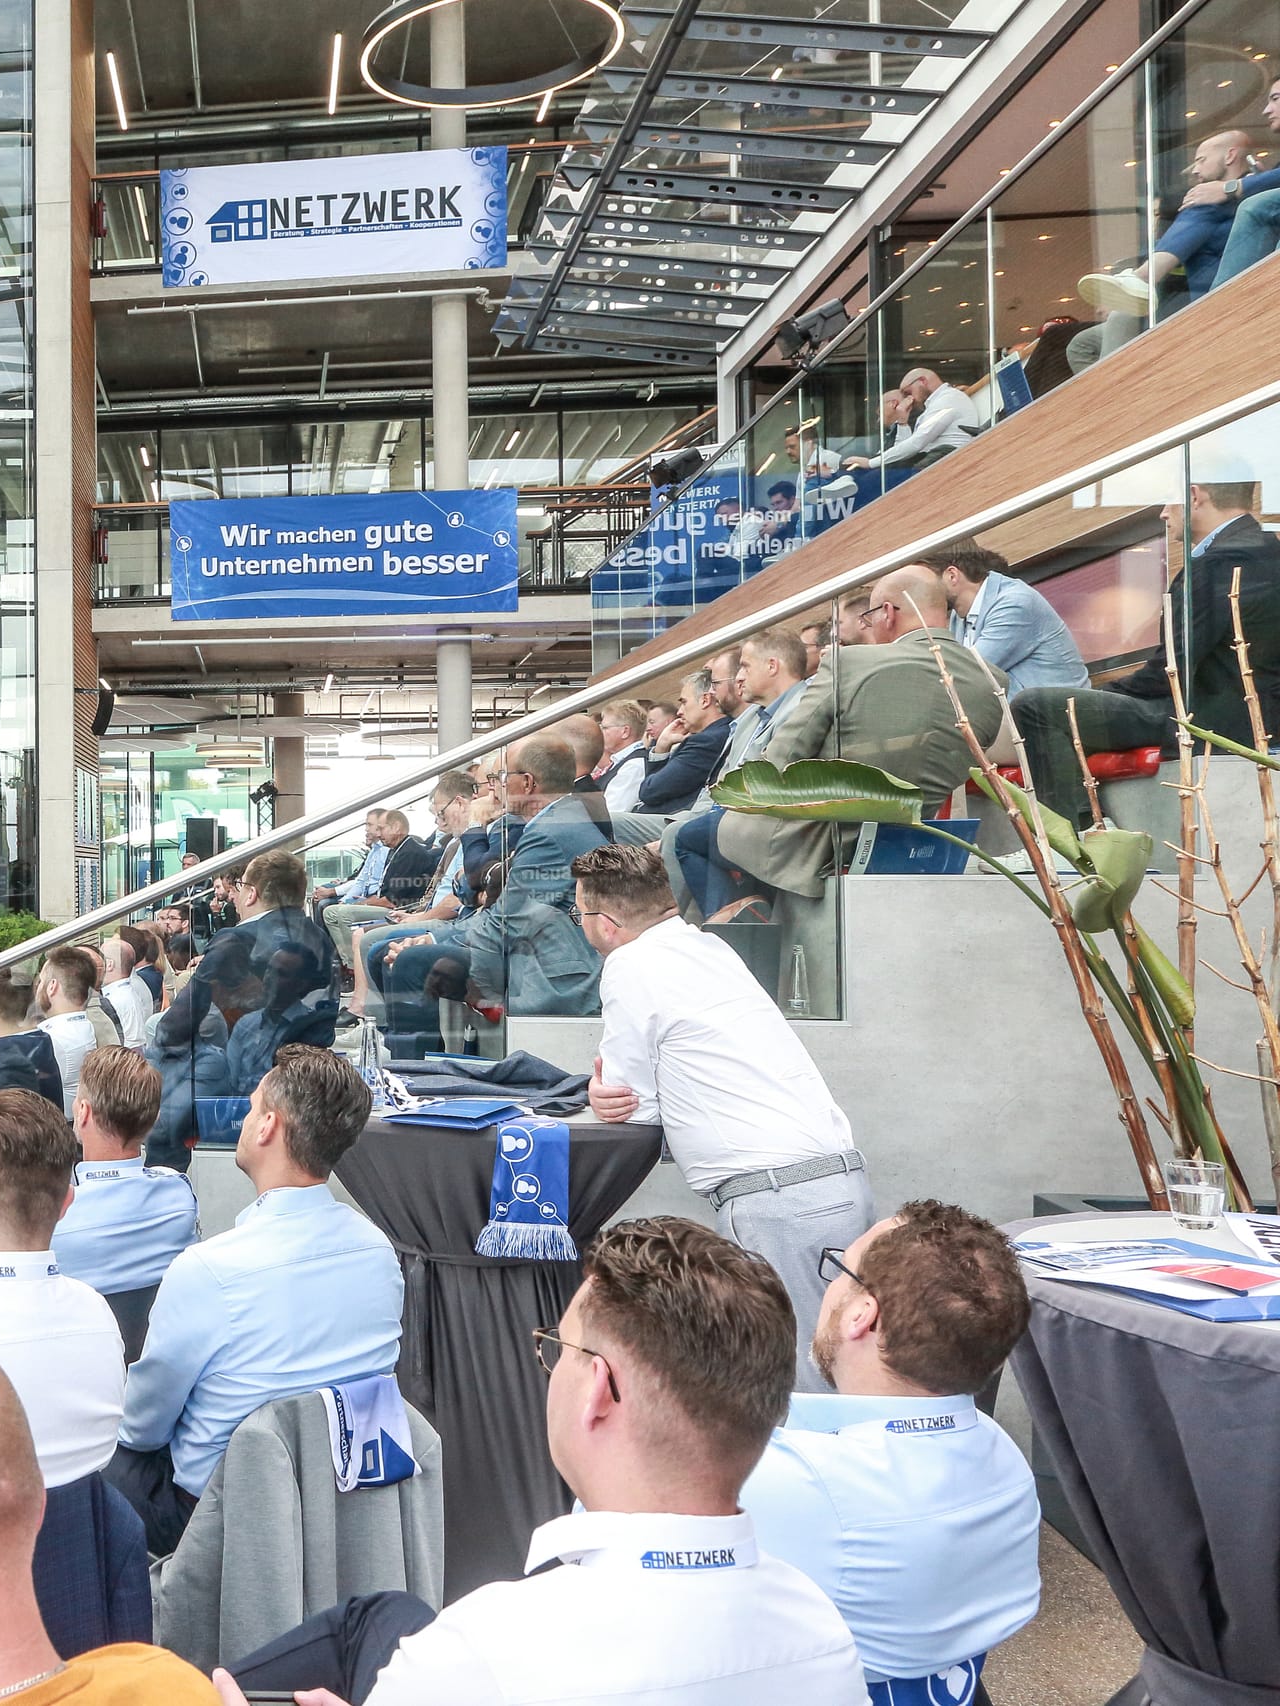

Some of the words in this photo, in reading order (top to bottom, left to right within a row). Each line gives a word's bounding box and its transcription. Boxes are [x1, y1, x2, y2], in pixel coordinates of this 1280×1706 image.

[270, 185, 463, 229] NETZWERK
[273, 229, 305, 238] Beratung
[310, 227, 342, 236] Strategie
[348, 223, 403, 232] Partnerschaften
[409, 219, 461, 228] Kooperationen
[220, 523, 272, 547] Wir
[276, 526, 357, 545] machen
[364, 520, 434, 549] gute
[200, 553, 373, 577] Unternehmen
[383, 550, 490, 576] besser
[903, 1415, 955, 1430] NETZWERK
[665, 1548, 736, 1566] NETZWERK
